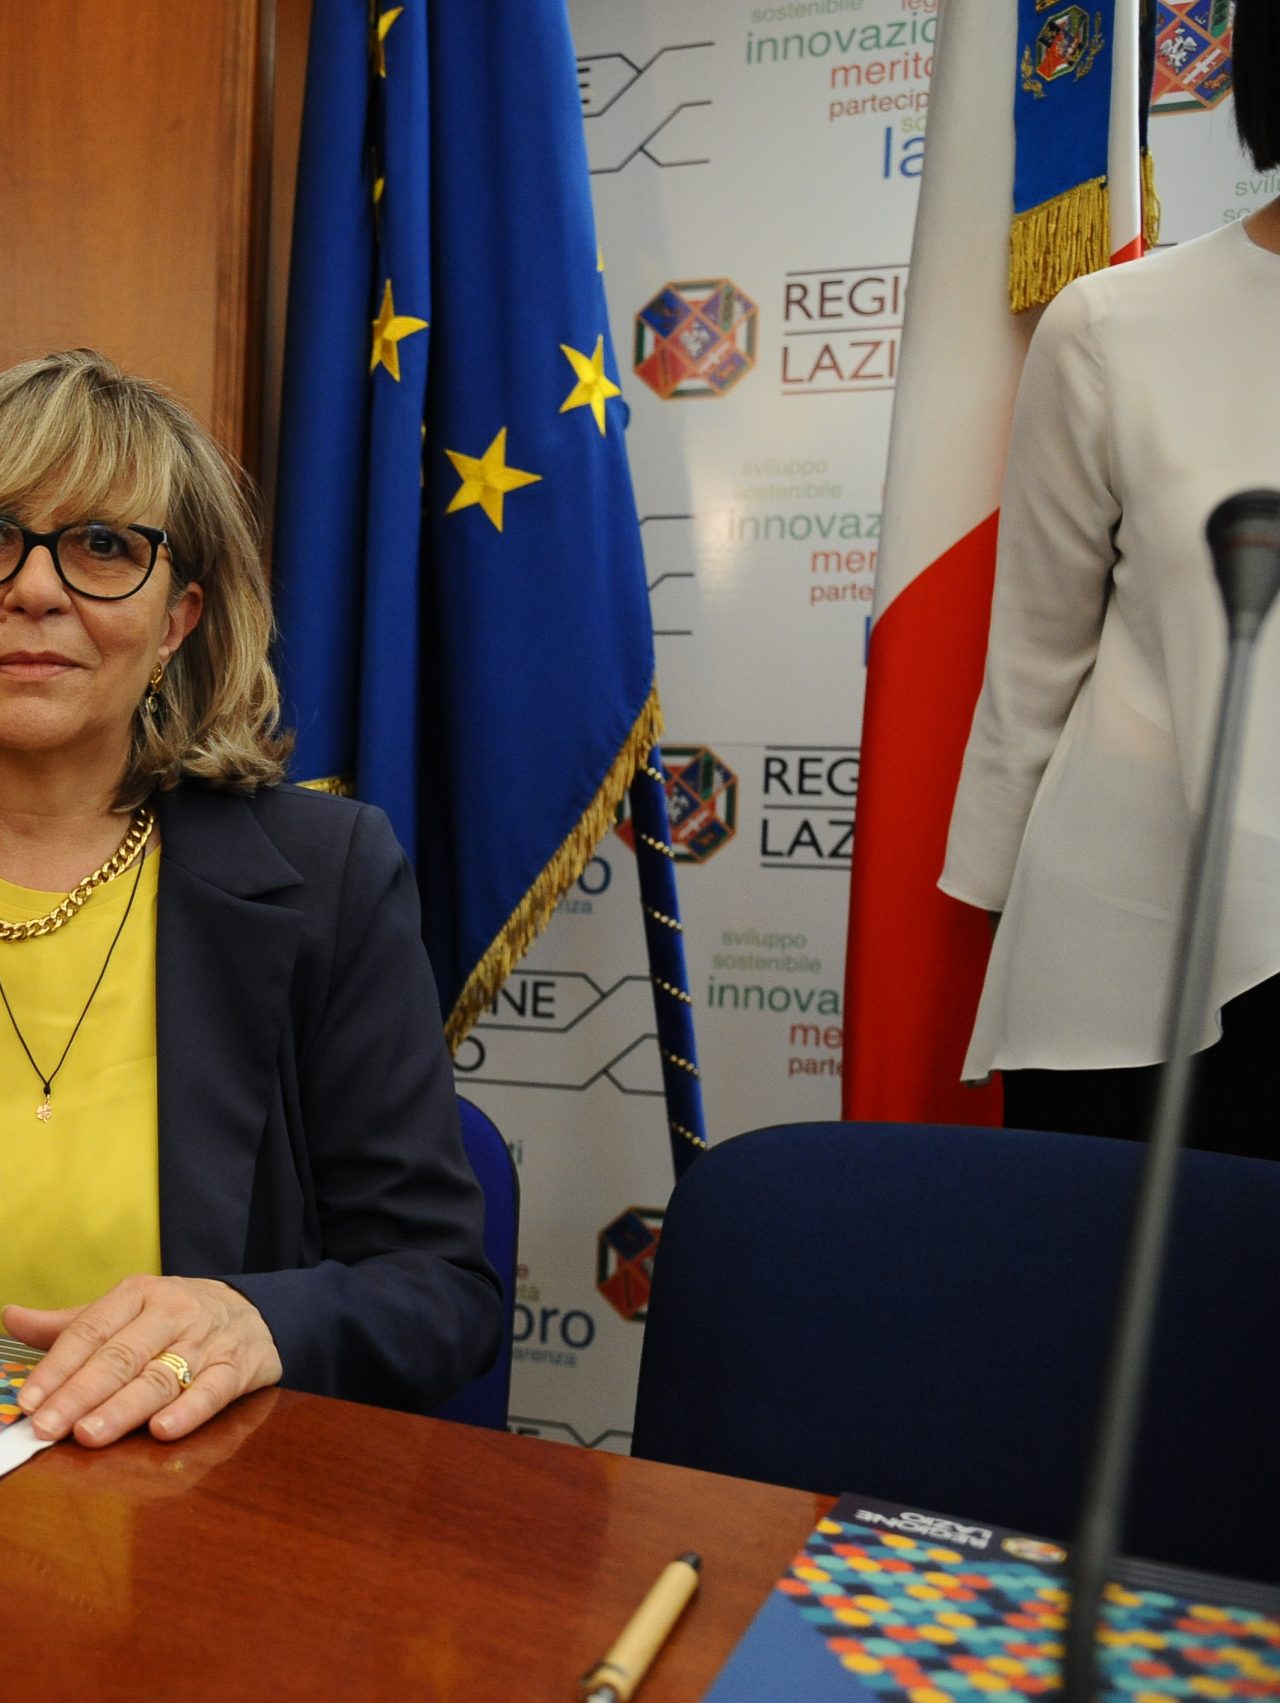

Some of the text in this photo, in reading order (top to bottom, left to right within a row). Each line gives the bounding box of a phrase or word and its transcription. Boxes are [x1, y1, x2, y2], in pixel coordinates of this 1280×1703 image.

[784, 275, 899, 321] REGI
[781, 339, 896, 384] LAZI
[763, 756, 860, 798] REG
[761, 818, 856, 859] LAZ
[721, 927, 809, 949] sviluppo
[853, 1509, 989, 1550] REGIONE
